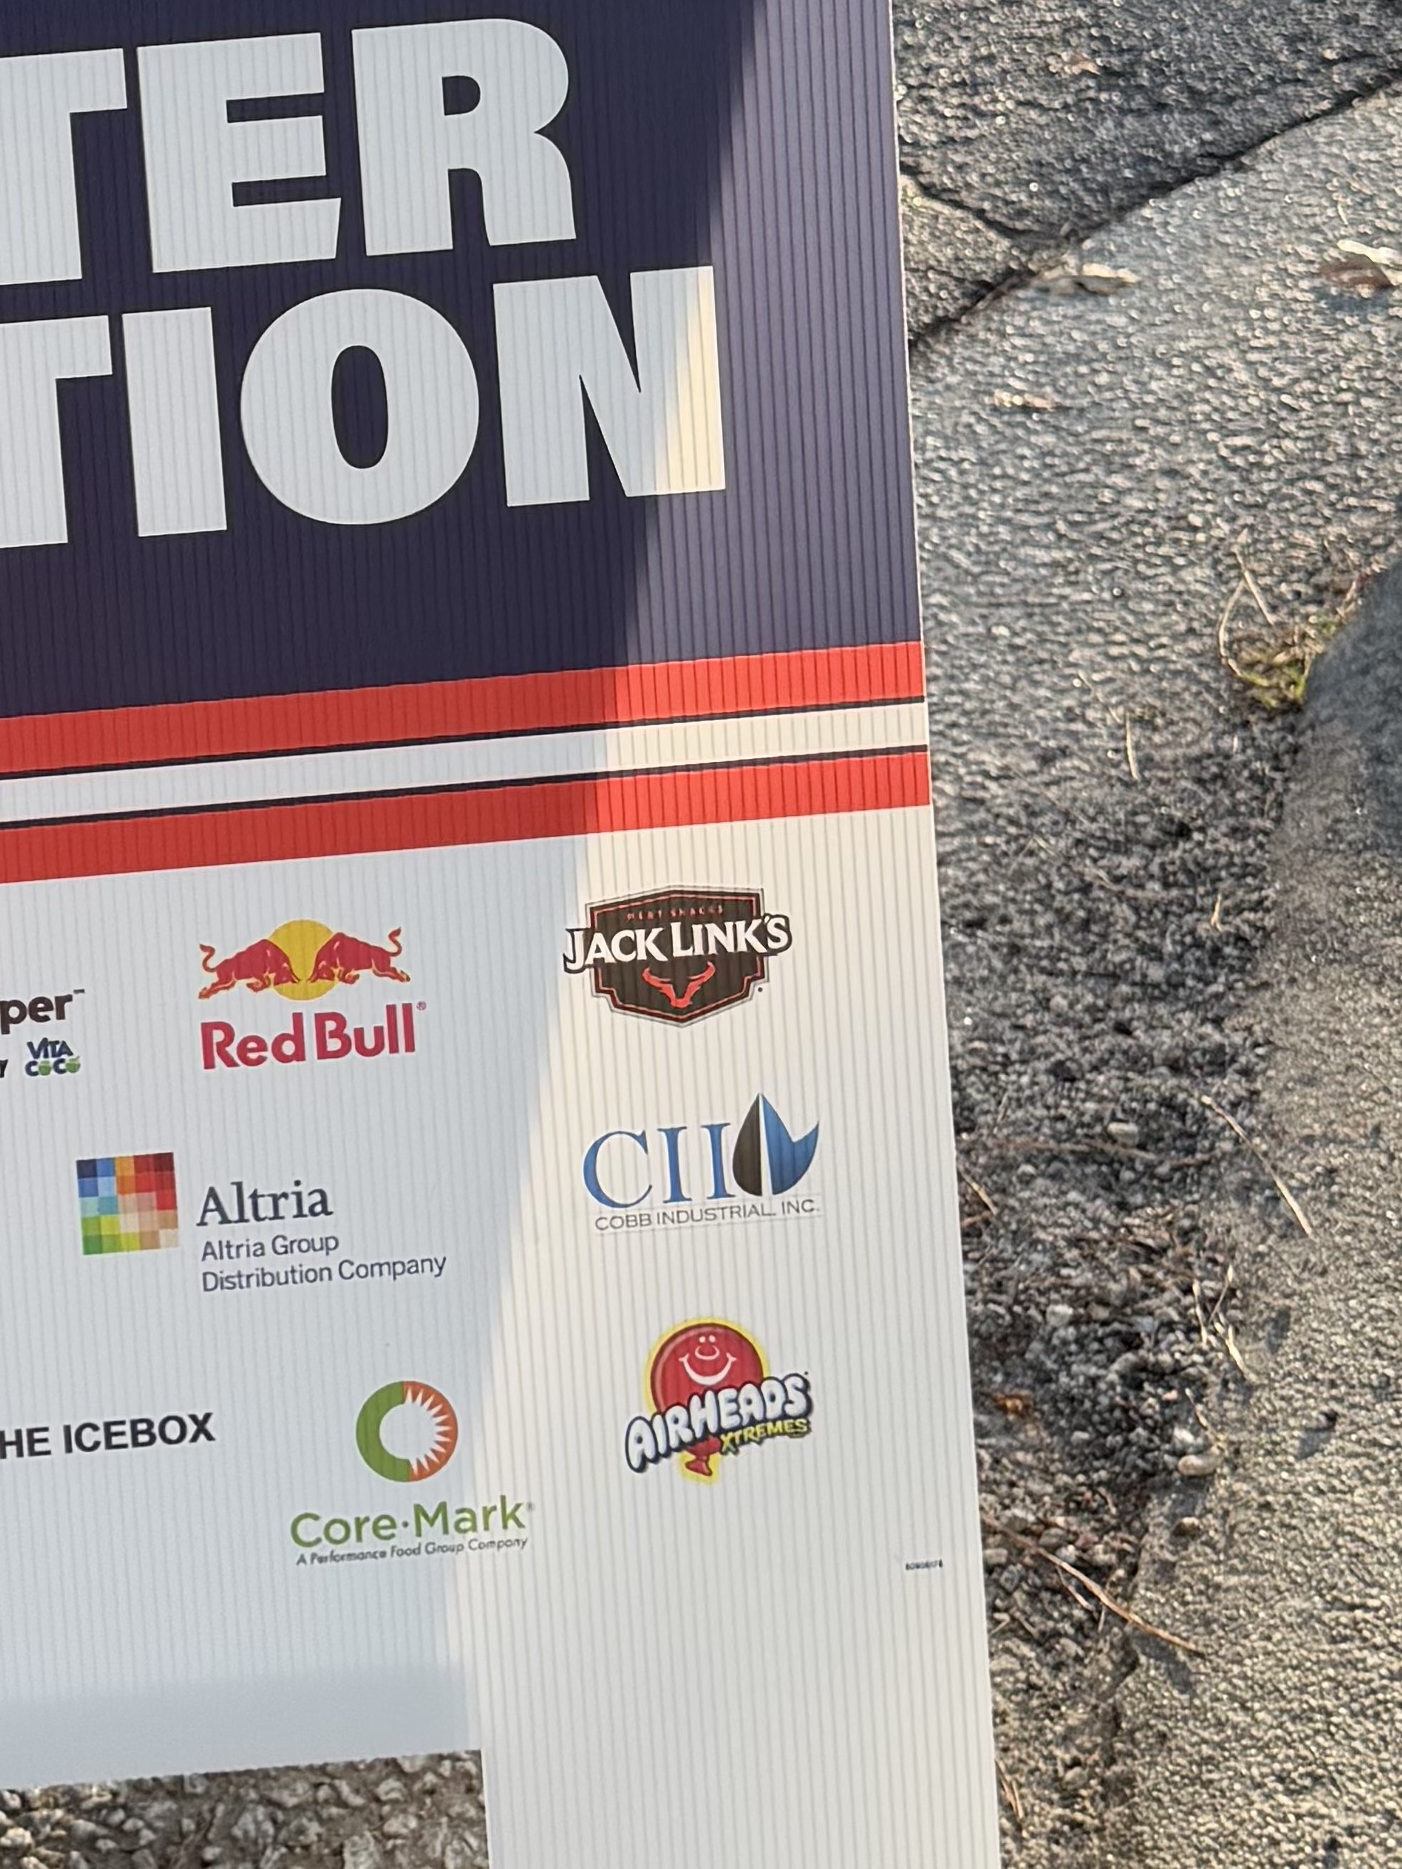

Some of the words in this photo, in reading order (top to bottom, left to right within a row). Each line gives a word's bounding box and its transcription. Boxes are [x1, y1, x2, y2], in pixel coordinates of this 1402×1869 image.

[564, 926, 669, 973] JACK
[671, 912, 791, 957] LINK'S
[26, 1037, 74, 1060] VITA
[200, 1012, 306, 1070] Red
[314, 1002, 416, 1061] Bull
[24, 1056, 82, 1077] COCO
[195, 1180, 334, 1227] Altria
[595, 1213, 653, 1231] COBB
[201, 1240, 267, 1262] Altria
[271, 1234, 340, 1257] Group
[202, 1264, 333, 1292] Distribution
[338, 1256, 447, 1281] Company
[63, 1412, 216, 1454] ICEBOX
[625, 1372, 813, 1473] AIRHEADS
[720, 1418, 813, 1456] XTREMES
[296, 1553, 307, 1566] A
[310, 1549, 387, 1565] Performance
[391, 1542, 422, 1558] Food
[425, 1541, 464, 1556] Group
[468, 1537, 529, 1552] Company
